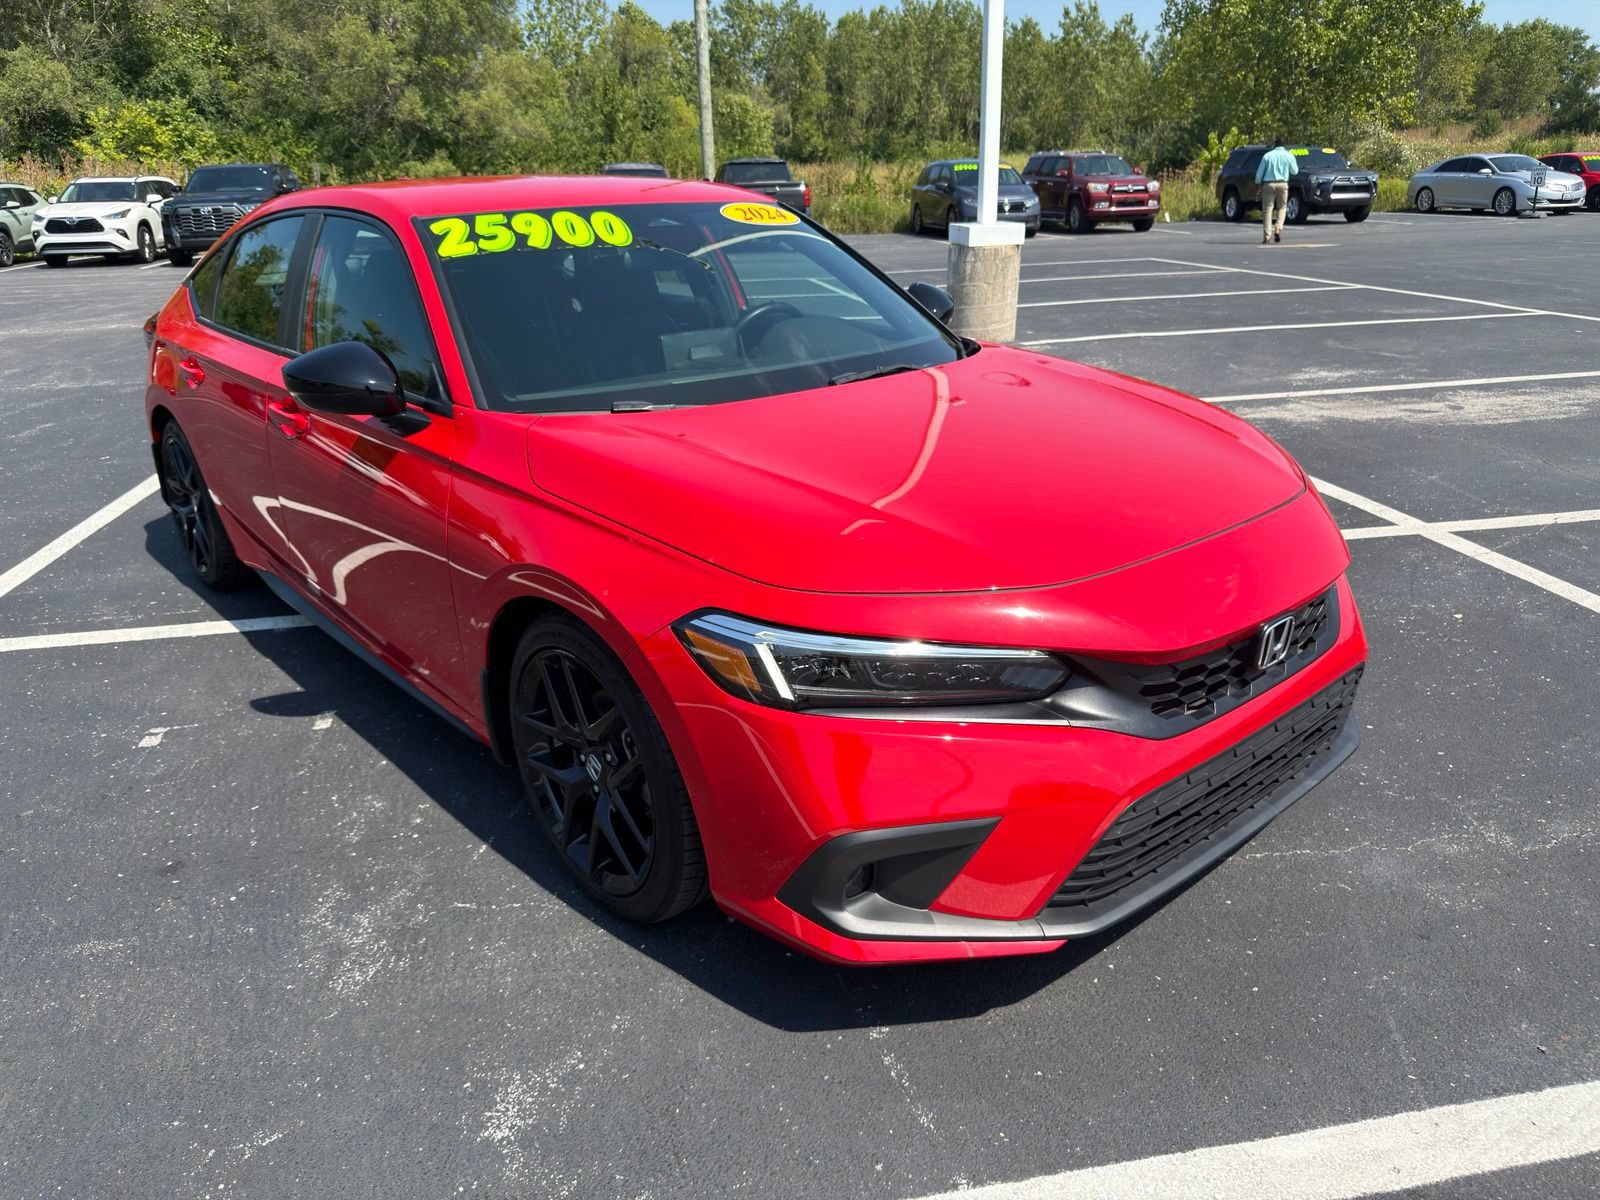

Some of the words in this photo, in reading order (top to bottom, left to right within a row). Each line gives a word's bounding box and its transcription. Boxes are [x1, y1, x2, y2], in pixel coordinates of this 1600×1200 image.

[1533, 176, 1542, 184] 10
[735, 207, 787, 220] 2024
[430, 211, 633, 258] 25900
